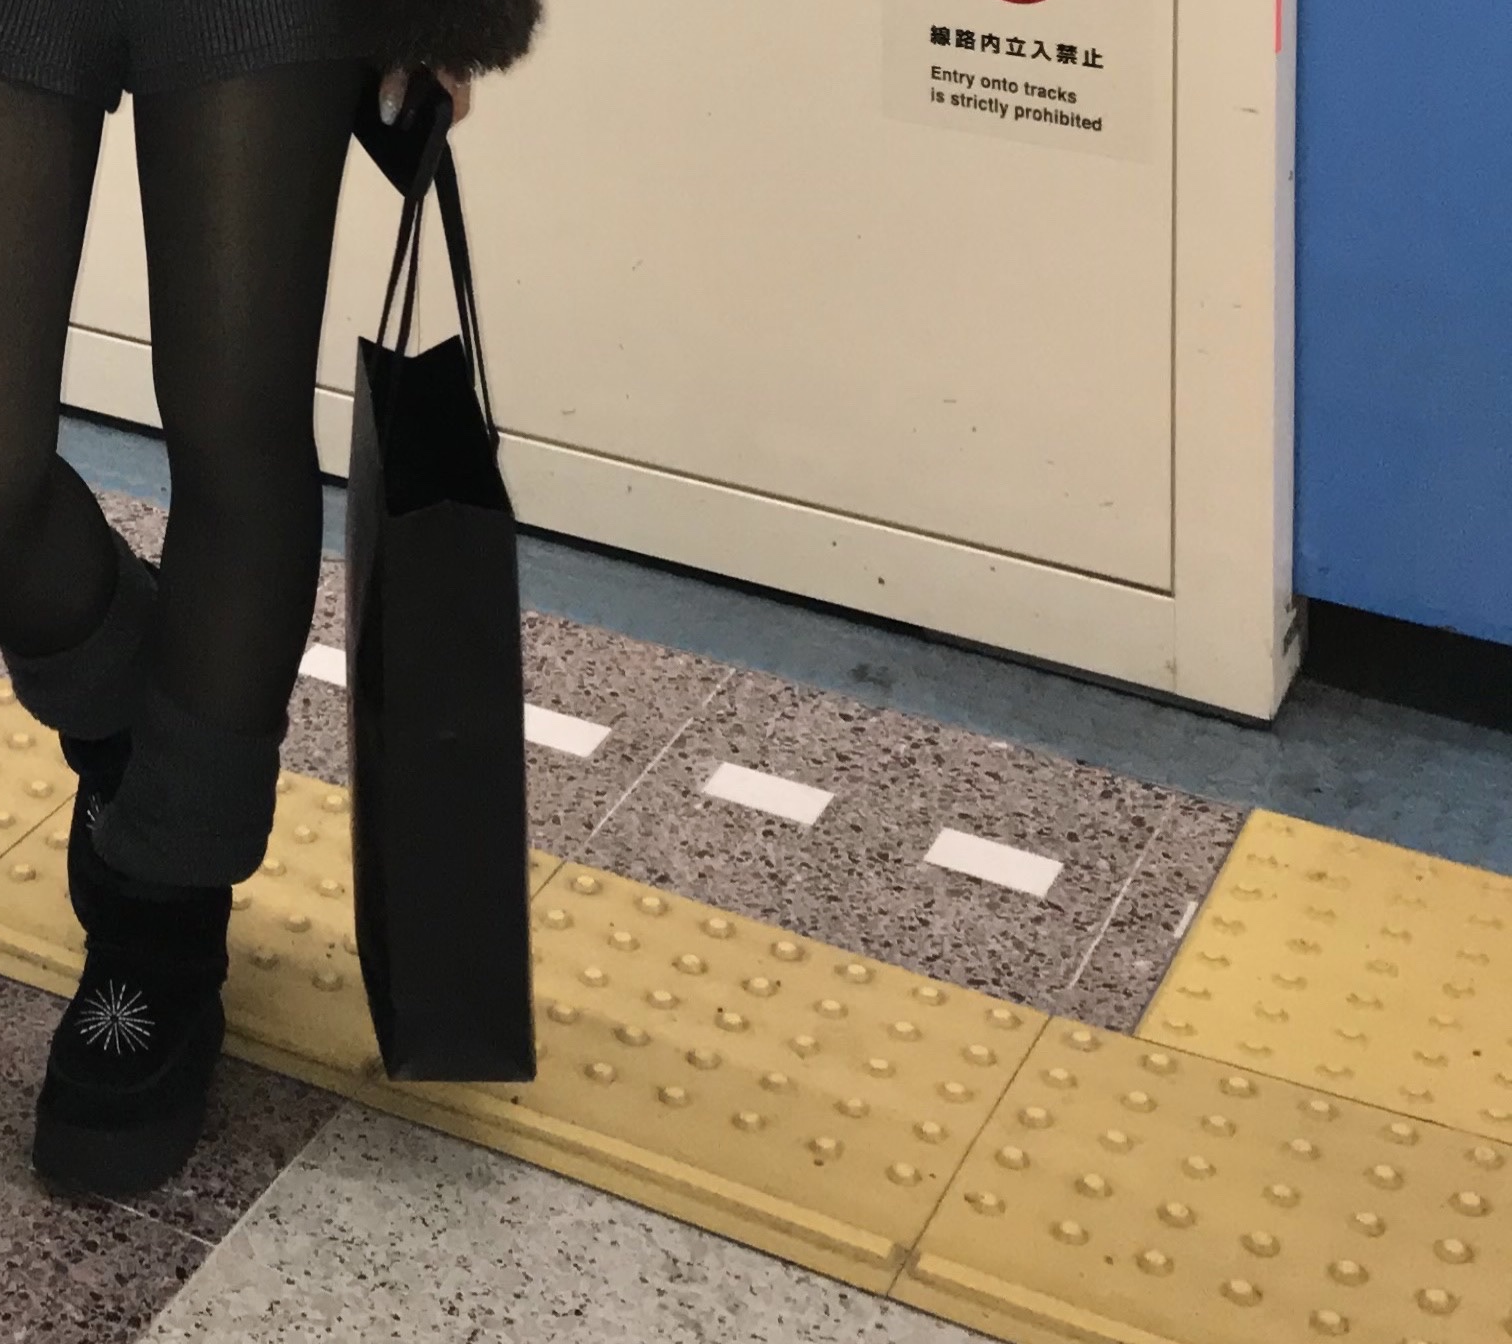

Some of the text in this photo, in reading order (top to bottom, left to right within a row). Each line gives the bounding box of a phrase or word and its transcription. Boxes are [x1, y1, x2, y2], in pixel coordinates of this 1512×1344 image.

[930, 25, 1104, 69] 線路内立入禁止
[931, 65, 1077, 104] Entry onto tracks
[930, 87, 1103, 132] is strictly prohibited
